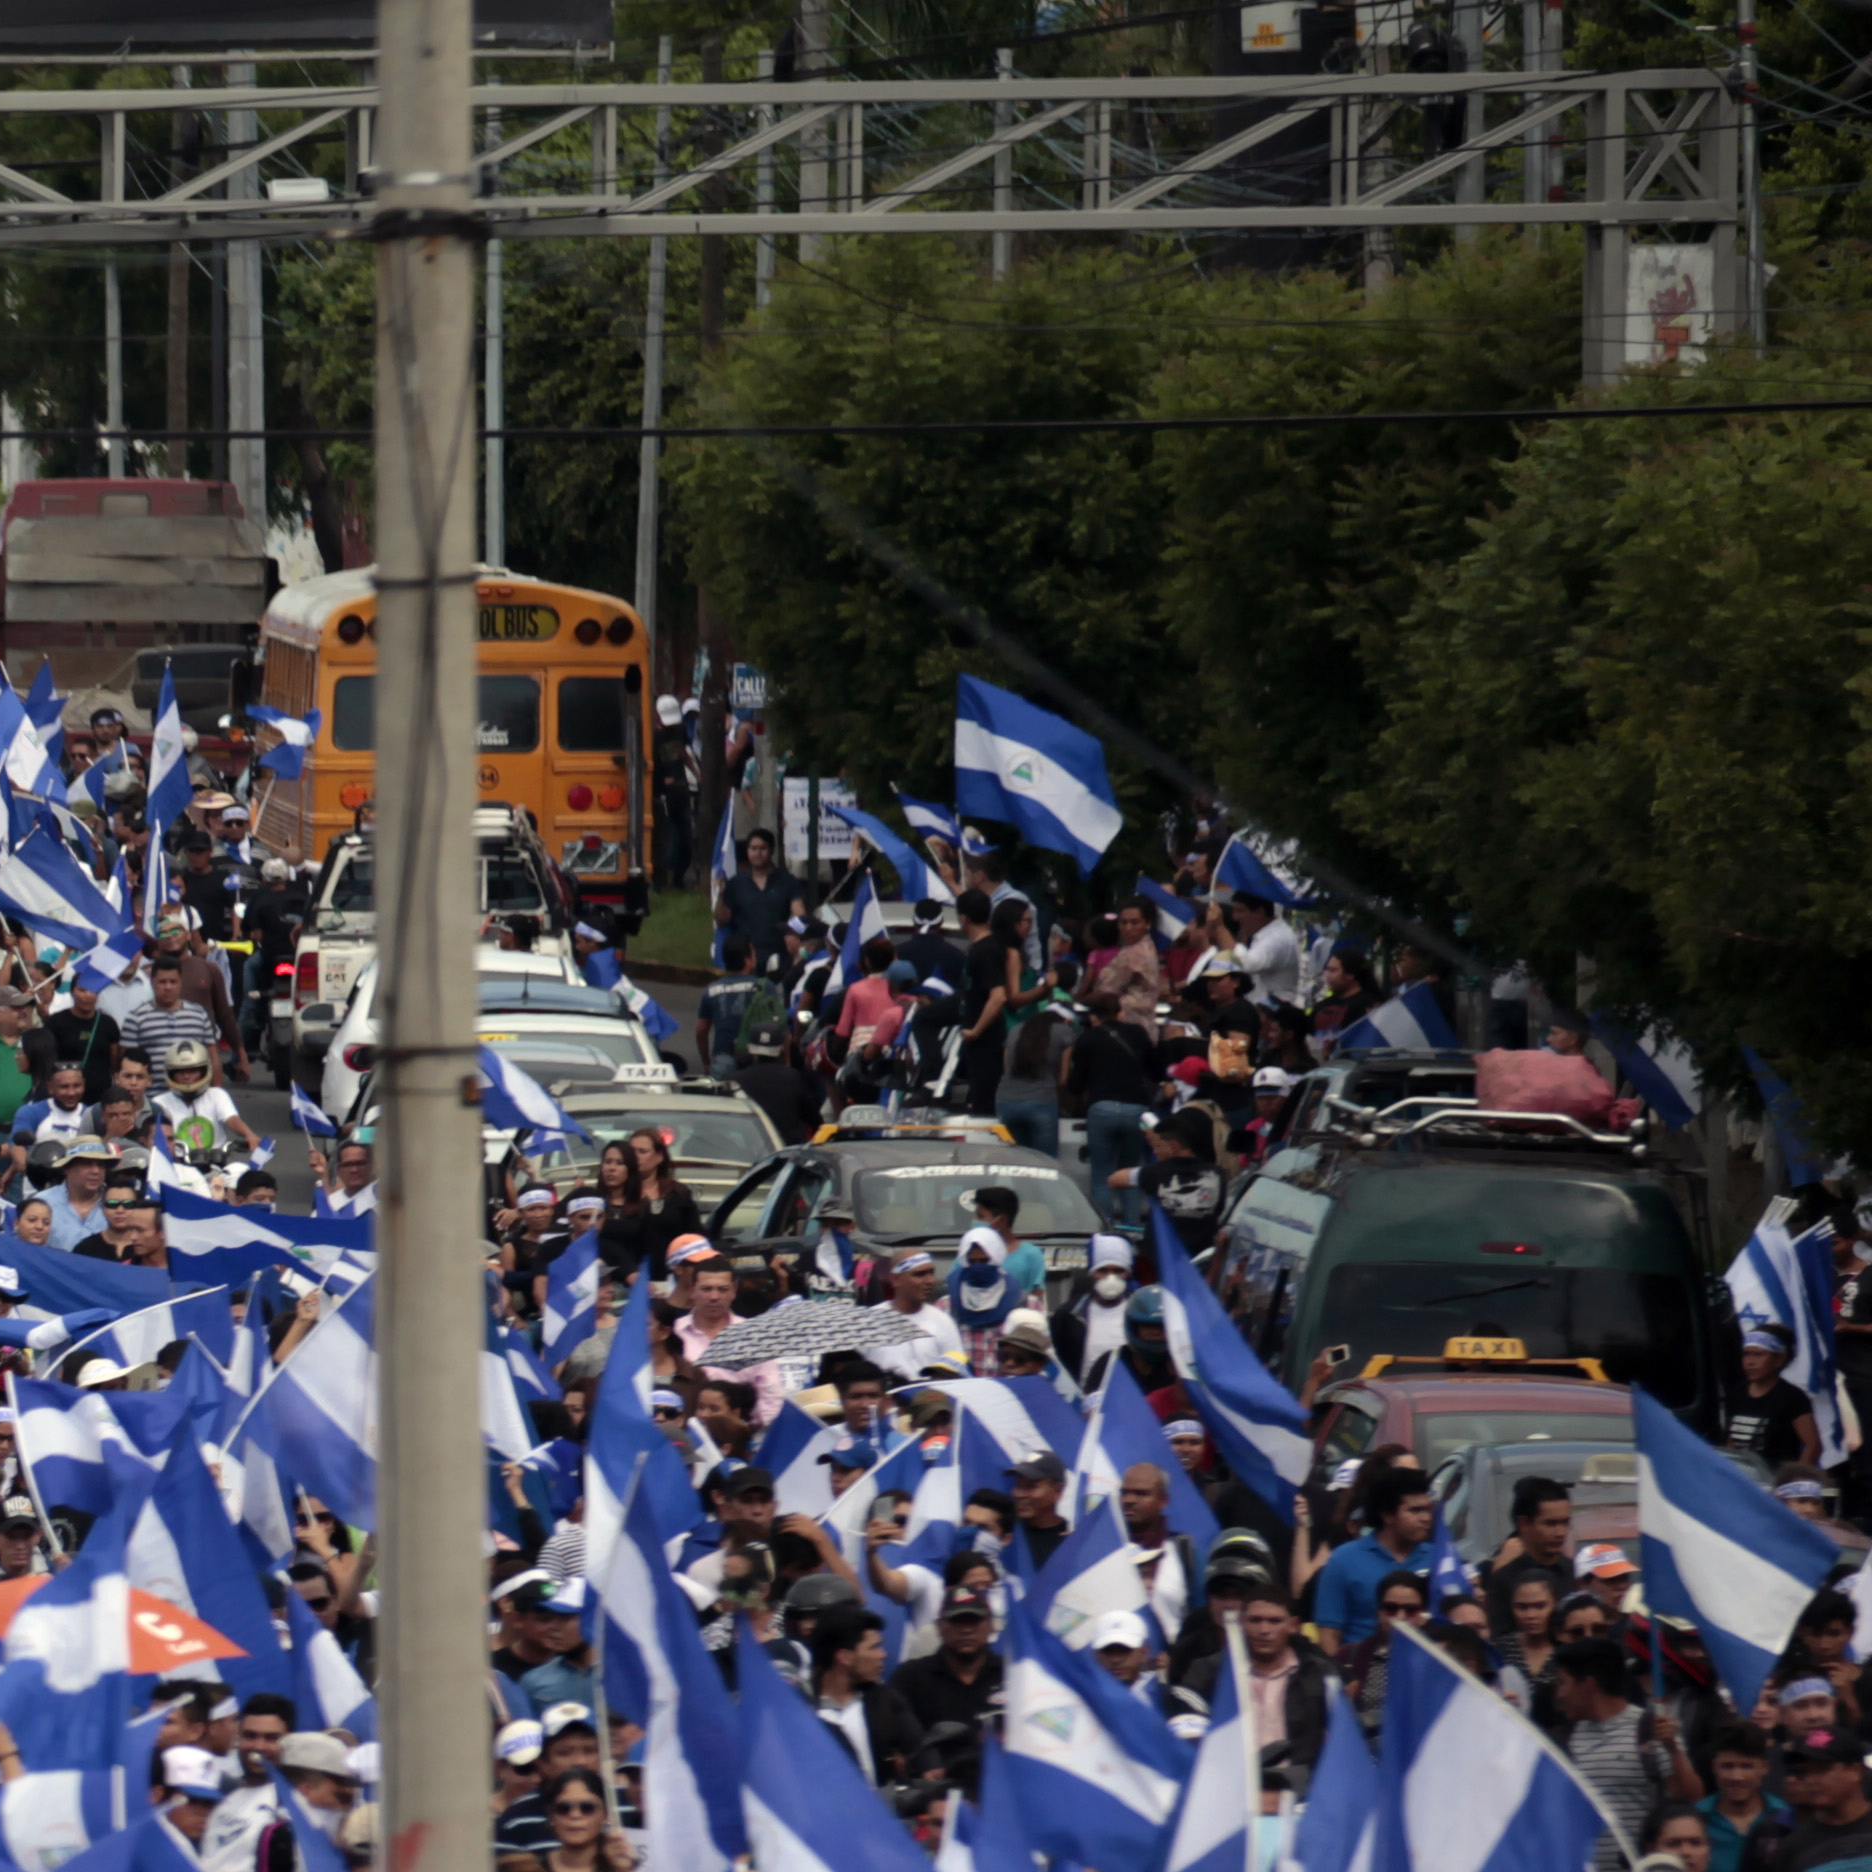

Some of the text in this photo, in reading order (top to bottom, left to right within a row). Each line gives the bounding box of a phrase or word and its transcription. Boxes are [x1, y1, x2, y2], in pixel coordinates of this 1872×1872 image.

[504, 610, 539, 638] BUS
[625, 1067, 668, 1078] TAXI
[1457, 1341, 1518, 1354] TAXI
